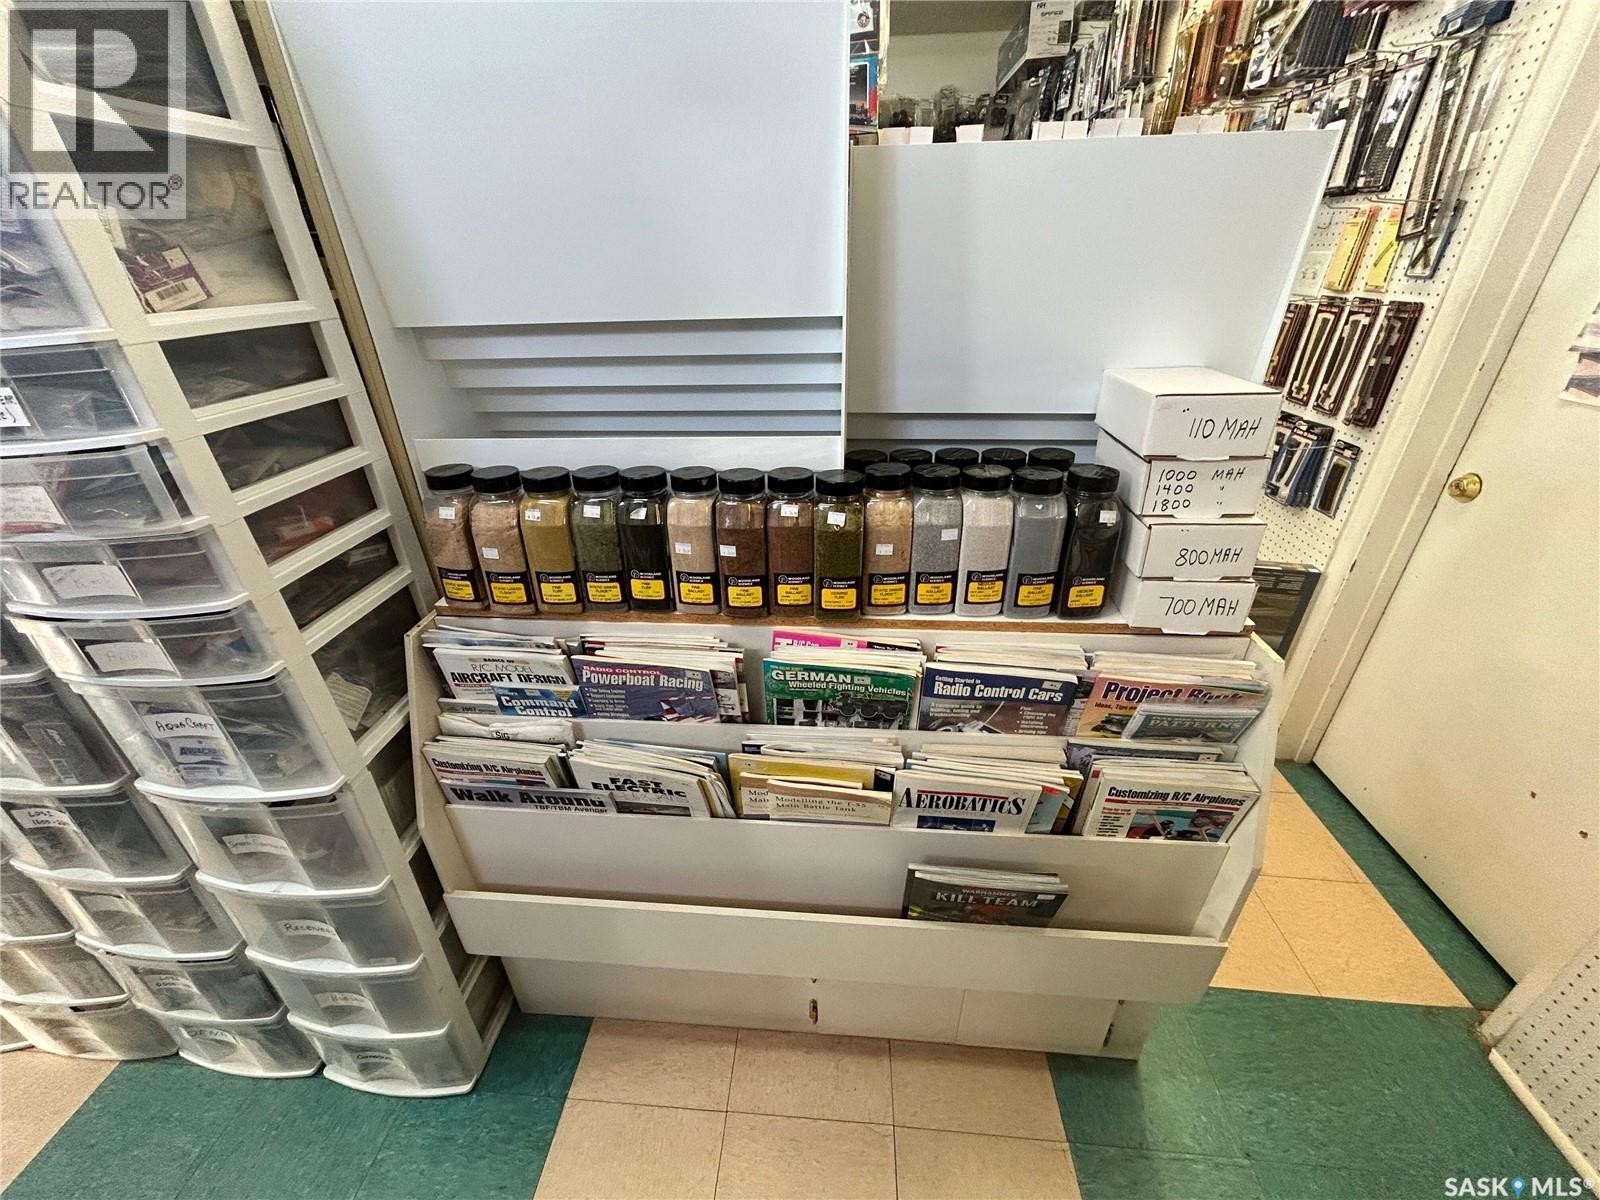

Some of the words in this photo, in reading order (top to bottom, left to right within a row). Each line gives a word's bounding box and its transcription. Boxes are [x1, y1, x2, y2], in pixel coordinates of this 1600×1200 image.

[1188, 418, 1215, 439] 110
[1218, 417, 1262, 440] MAH
[1158, 468, 1198, 483] 1000
[1211, 466, 1246, 481] MAH
[1155, 484, 1194, 497] 1400
[1152, 499, 1191, 512] 1800
[1174, 547, 1209, 567] 800
[1209, 547, 1243, 565] MAH
[1159, 596, 1197, 617] 700
[1197, 597, 1240, 617] MAH
[494, 663, 534, 673] MODEL
[582, 665, 613, 673] RADIO
[449, 671, 513, 683] AIRCRAFT
[517, 673, 568, 685] DESIGN
[582, 669, 655, 686] Powerboat
[659, 674, 704, 692] Racing
[771, 669, 851, 684] GERMAN
[935, 675, 954, 683] Getting
[788, 680, 827, 690] Wheeled
[828, 682, 866, 693] Fighting
[867, 685, 907, 696] Vehicles
[933, 681, 971, 696] Radio
[974, 683, 1026, 699] Control
[1028, 687, 1064, 702] Cars
[1102, 681, 1183, 703] Project
[500, 695, 579, 709] Command
[1094, 702, 1114, 710] Ideas,
[514, 704, 574, 717] Control
[1149, 719, 1242, 731] PATTERNS
[431, 758, 483, 773] Customizing
[483, 764, 500, 773] R/C
[500, 765, 544, 777] Airplanes
[591, 781, 687, 798] ELECTRIC
[608, 777, 662, 788] FAST
[449, 787, 513, 803] Walk
[775, 796, 823, 806] Modelling
[899, 787, 1026, 816] AEROBATICS
[1107, 786, 1170, 801] Customizing
[1171, 791, 1192, 802] R/C
[1191, 793, 1247, 807] Airplanes
[573, 806, 608, 814] Avenger
[803, 803, 831, 811] Battle
[834, 805, 857, 813] Tank
[935, 891, 977, 905] KILL
[982, 896, 1039, 908] TEAM
[961, 888, 1017, 898] WARHAMMER
